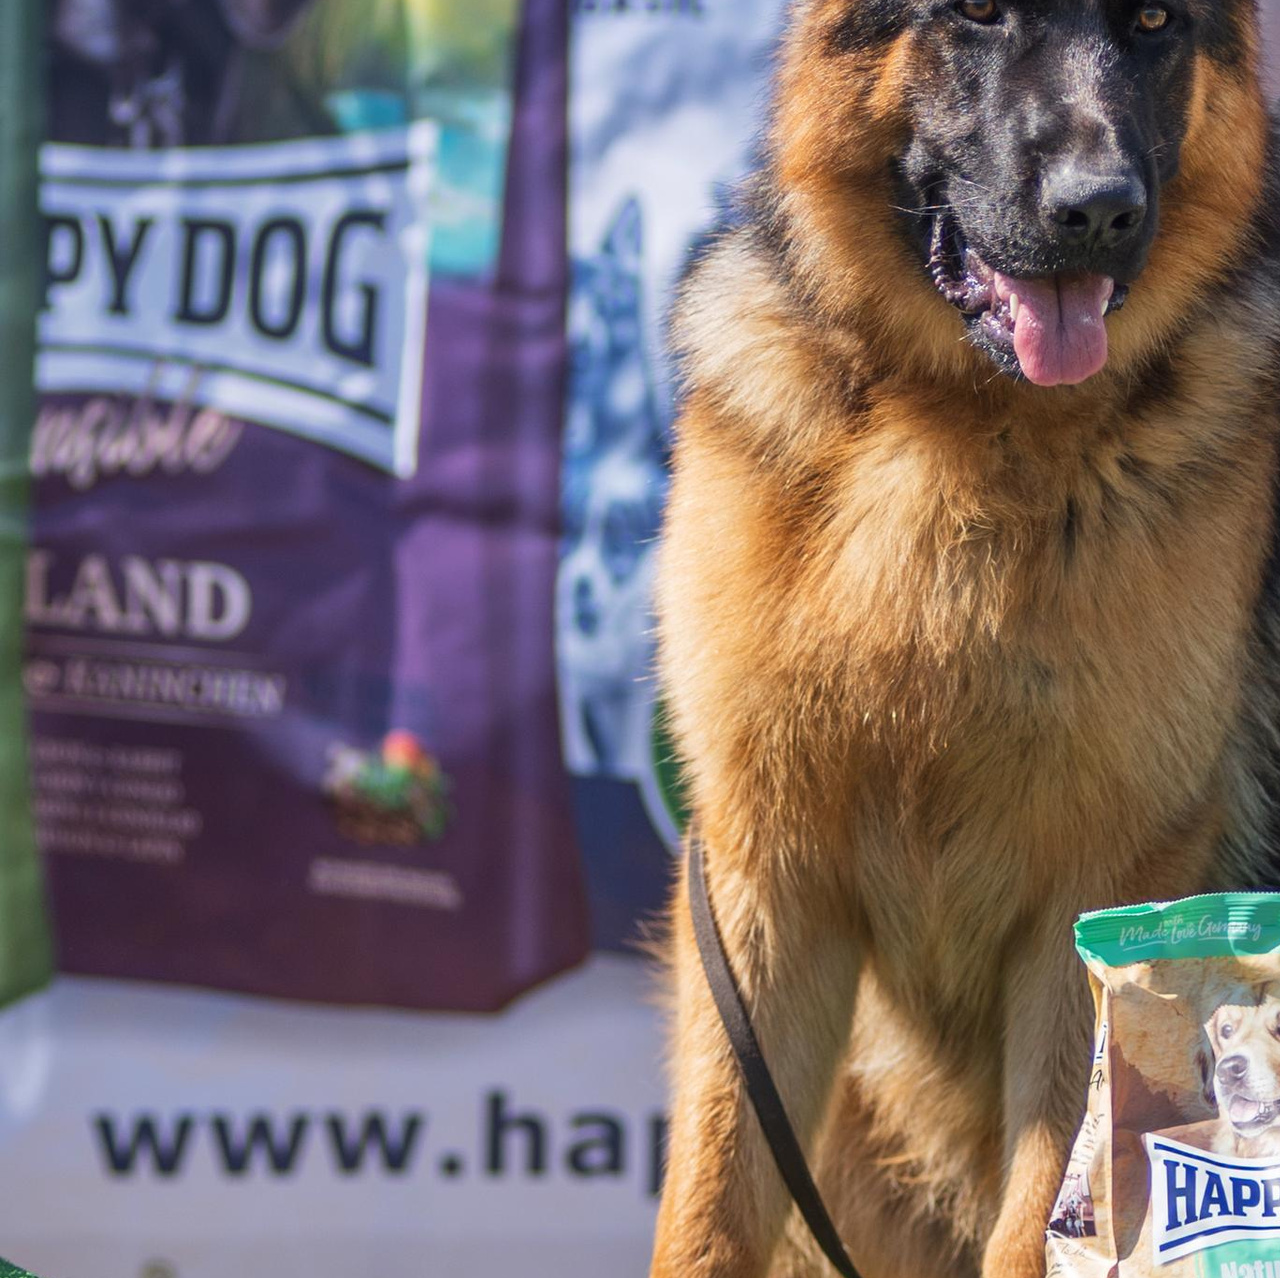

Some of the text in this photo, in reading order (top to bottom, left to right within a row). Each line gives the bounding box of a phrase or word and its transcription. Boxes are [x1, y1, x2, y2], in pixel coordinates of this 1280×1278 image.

[175, 212, 389, 369] DOG
[25, 549, 252, 641] LAND
[1119, 922, 1168, 946] Made
[1170, 925, 1197, 945] Love
